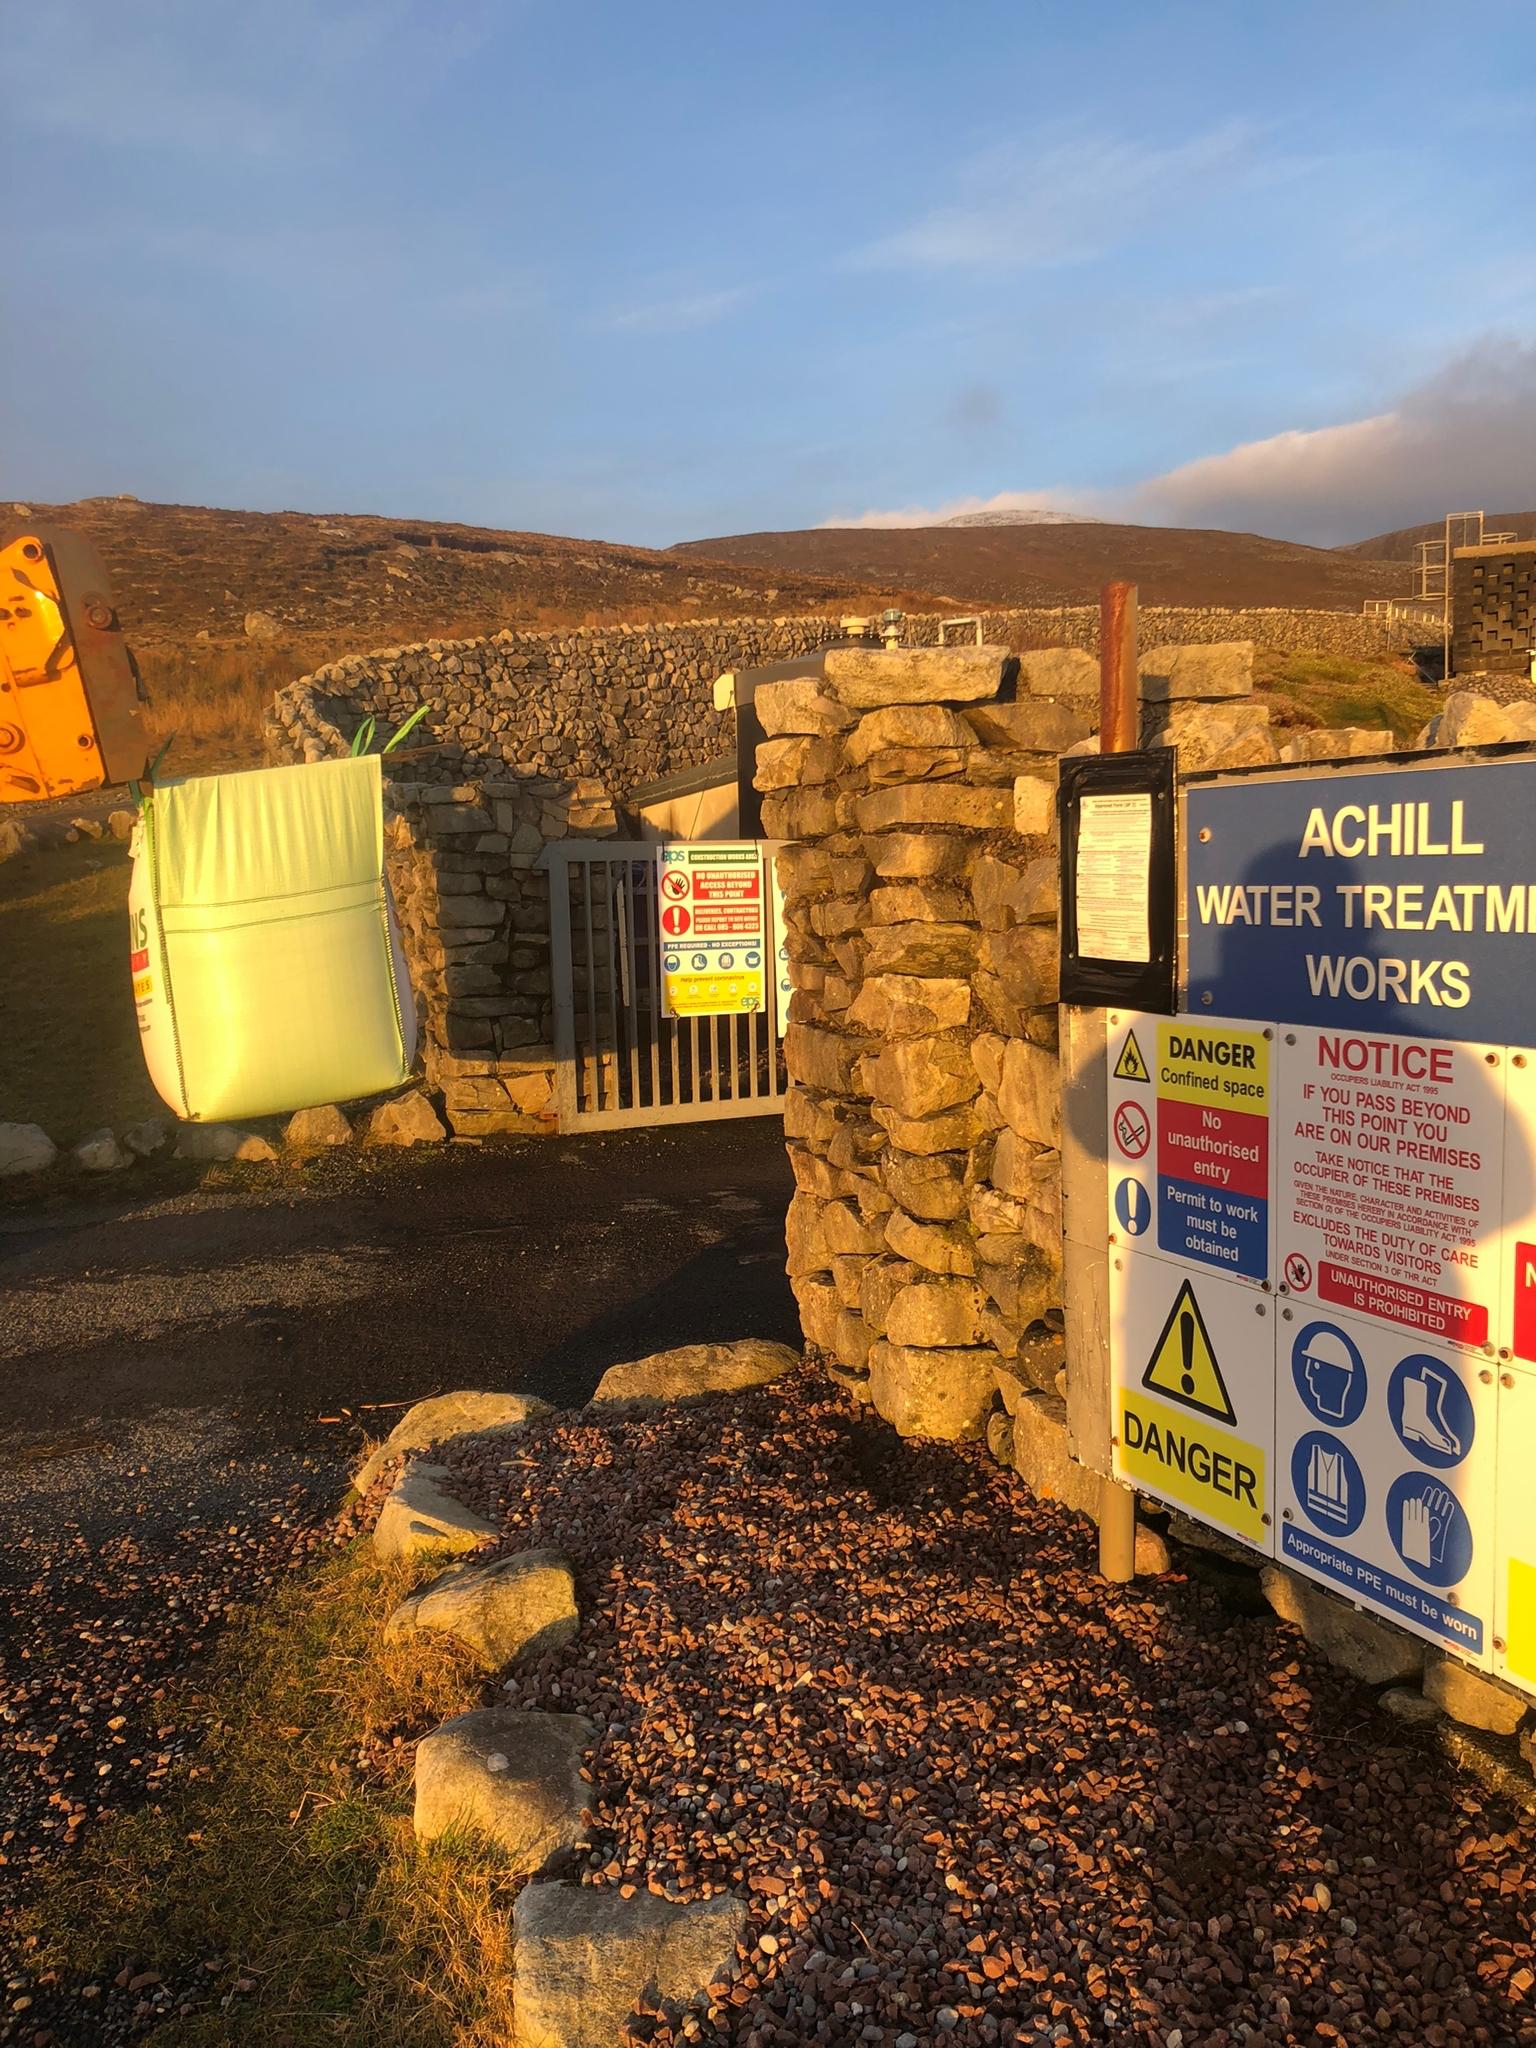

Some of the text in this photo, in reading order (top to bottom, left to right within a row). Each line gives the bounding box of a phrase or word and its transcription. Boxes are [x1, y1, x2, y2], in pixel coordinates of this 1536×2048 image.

[1299, 801, 1484, 858] ACHILL
[708, 890, 724, 898] THIS
[1196, 885, 1323, 927] WATER
[1306, 953, 1471, 1008] WORKS
[1169, 1036, 1256, 1069] DANGER
[1318, 1036, 1453, 1084] NOTICE
[1161, 1068, 1264, 1098] Confined space
[1331, 1073, 1439, 1095] OCCUPIERS LIABILITY ACT 1995
[1202, 1111, 1221, 1129] No
[1304, 1084, 1470, 1124] IF YOU PASS BEYOND
[1322, 1107, 1448, 1142] THIS POINT YOU
[1168, 1131, 1259, 1162] unauthorised
[1294, 1122, 1480, 1170] ARE ON OUR PREMISES
[1194, 1162, 1230, 1185] entry
[1294, 1161, 1480, 1212] OCCUPIER OF THESE PREMISES
[1315, 1151, 1454, 1190] TAKE NOTICE THAT THE
[1167, 1186, 1258, 1223] Permit to work
[1294, 1180, 1313, 1191] GIVEN
[1315, 1185, 1328, 1194] THE
[1360, 1195, 1404, 1211] CHARACTER
[1407, 1206, 1422, 1215] AND
[1425, 1210, 1465, 1225] ACTIVITIES
[1468, 1219, 1479, 1228] OF
[1296, 1198, 1323, 1210] SECTION
[1346, 1210, 1359, 1219] THE
[1361, 1213, 1401, 1229] OCCUPIERS
[1403, 1224, 1439, 1238] LIABILITY
[1441, 1233, 1456, 1243] ACT
[1459, 1236, 1476, 1247] 1995
[1300, 1190, 1471, 1236] THESE PREMISES HEREBY IN ACCORDANCE WITH
[1187, 1215, 1237, 1239] must be
[1293, 1211, 1479, 1269] EXCLUDES THE DUTY OF CARE
[1186, 1236, 1238, 1261] obtained
[1323, 1234, 1441, 1275] TOWARDS VISITORS
[1326, 1249, 1349, 1263] UNDER
[1351, 1257, 1381, 1271] SECTION
[1391, 1268, 1401, 1276] OF
[1404, 1271, 1419, 1282] THR
[1422, 1276, 1437, 1286] ACT
[1331, 1270, 1472, 1321] UNAUTHORISED ENTRY
[1354, 1292, 1446, 1331] IS PROIHIBITED
[1125, 1410, 1258, 1510] DANGER
[1287, 1533, 1353, 1576] Appropriate
[1357, 1567, 1381, 1590] PPE
[1385, 1584, 1417, 1610] must
[1421, 1600, 1437, 1619] be
[1442, 1613, 1477, 1641] worn
